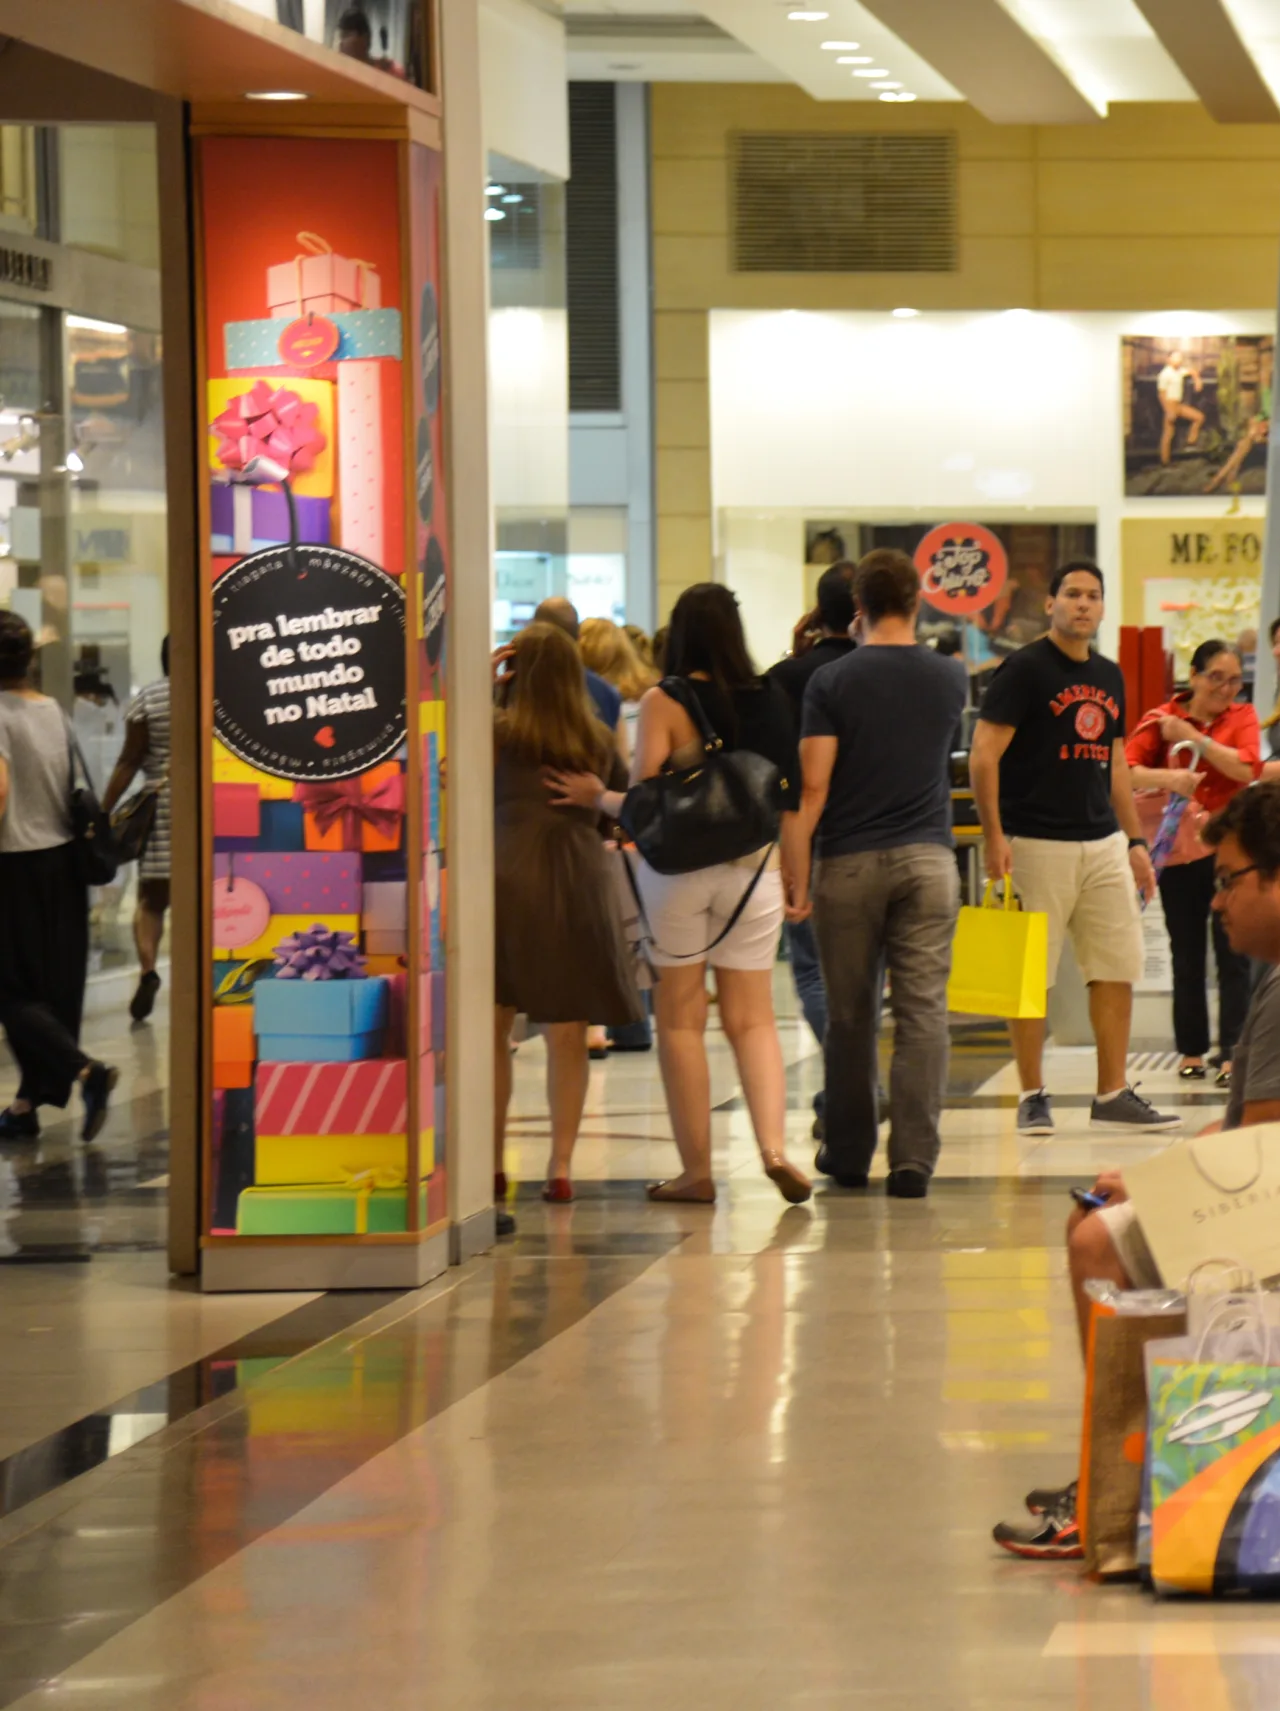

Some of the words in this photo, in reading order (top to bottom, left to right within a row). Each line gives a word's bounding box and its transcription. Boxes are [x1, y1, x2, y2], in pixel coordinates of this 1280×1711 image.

[227, 621, 276, 650] pra
[276, 605, 382, 638] lembrar
[260, 645, 296, 669] de
[297, 634, 362, 662] todo
[266, 662, 364, 696] mundo
[263, 705, 303, 726] no
[306, 686, 378, 719] Natal
